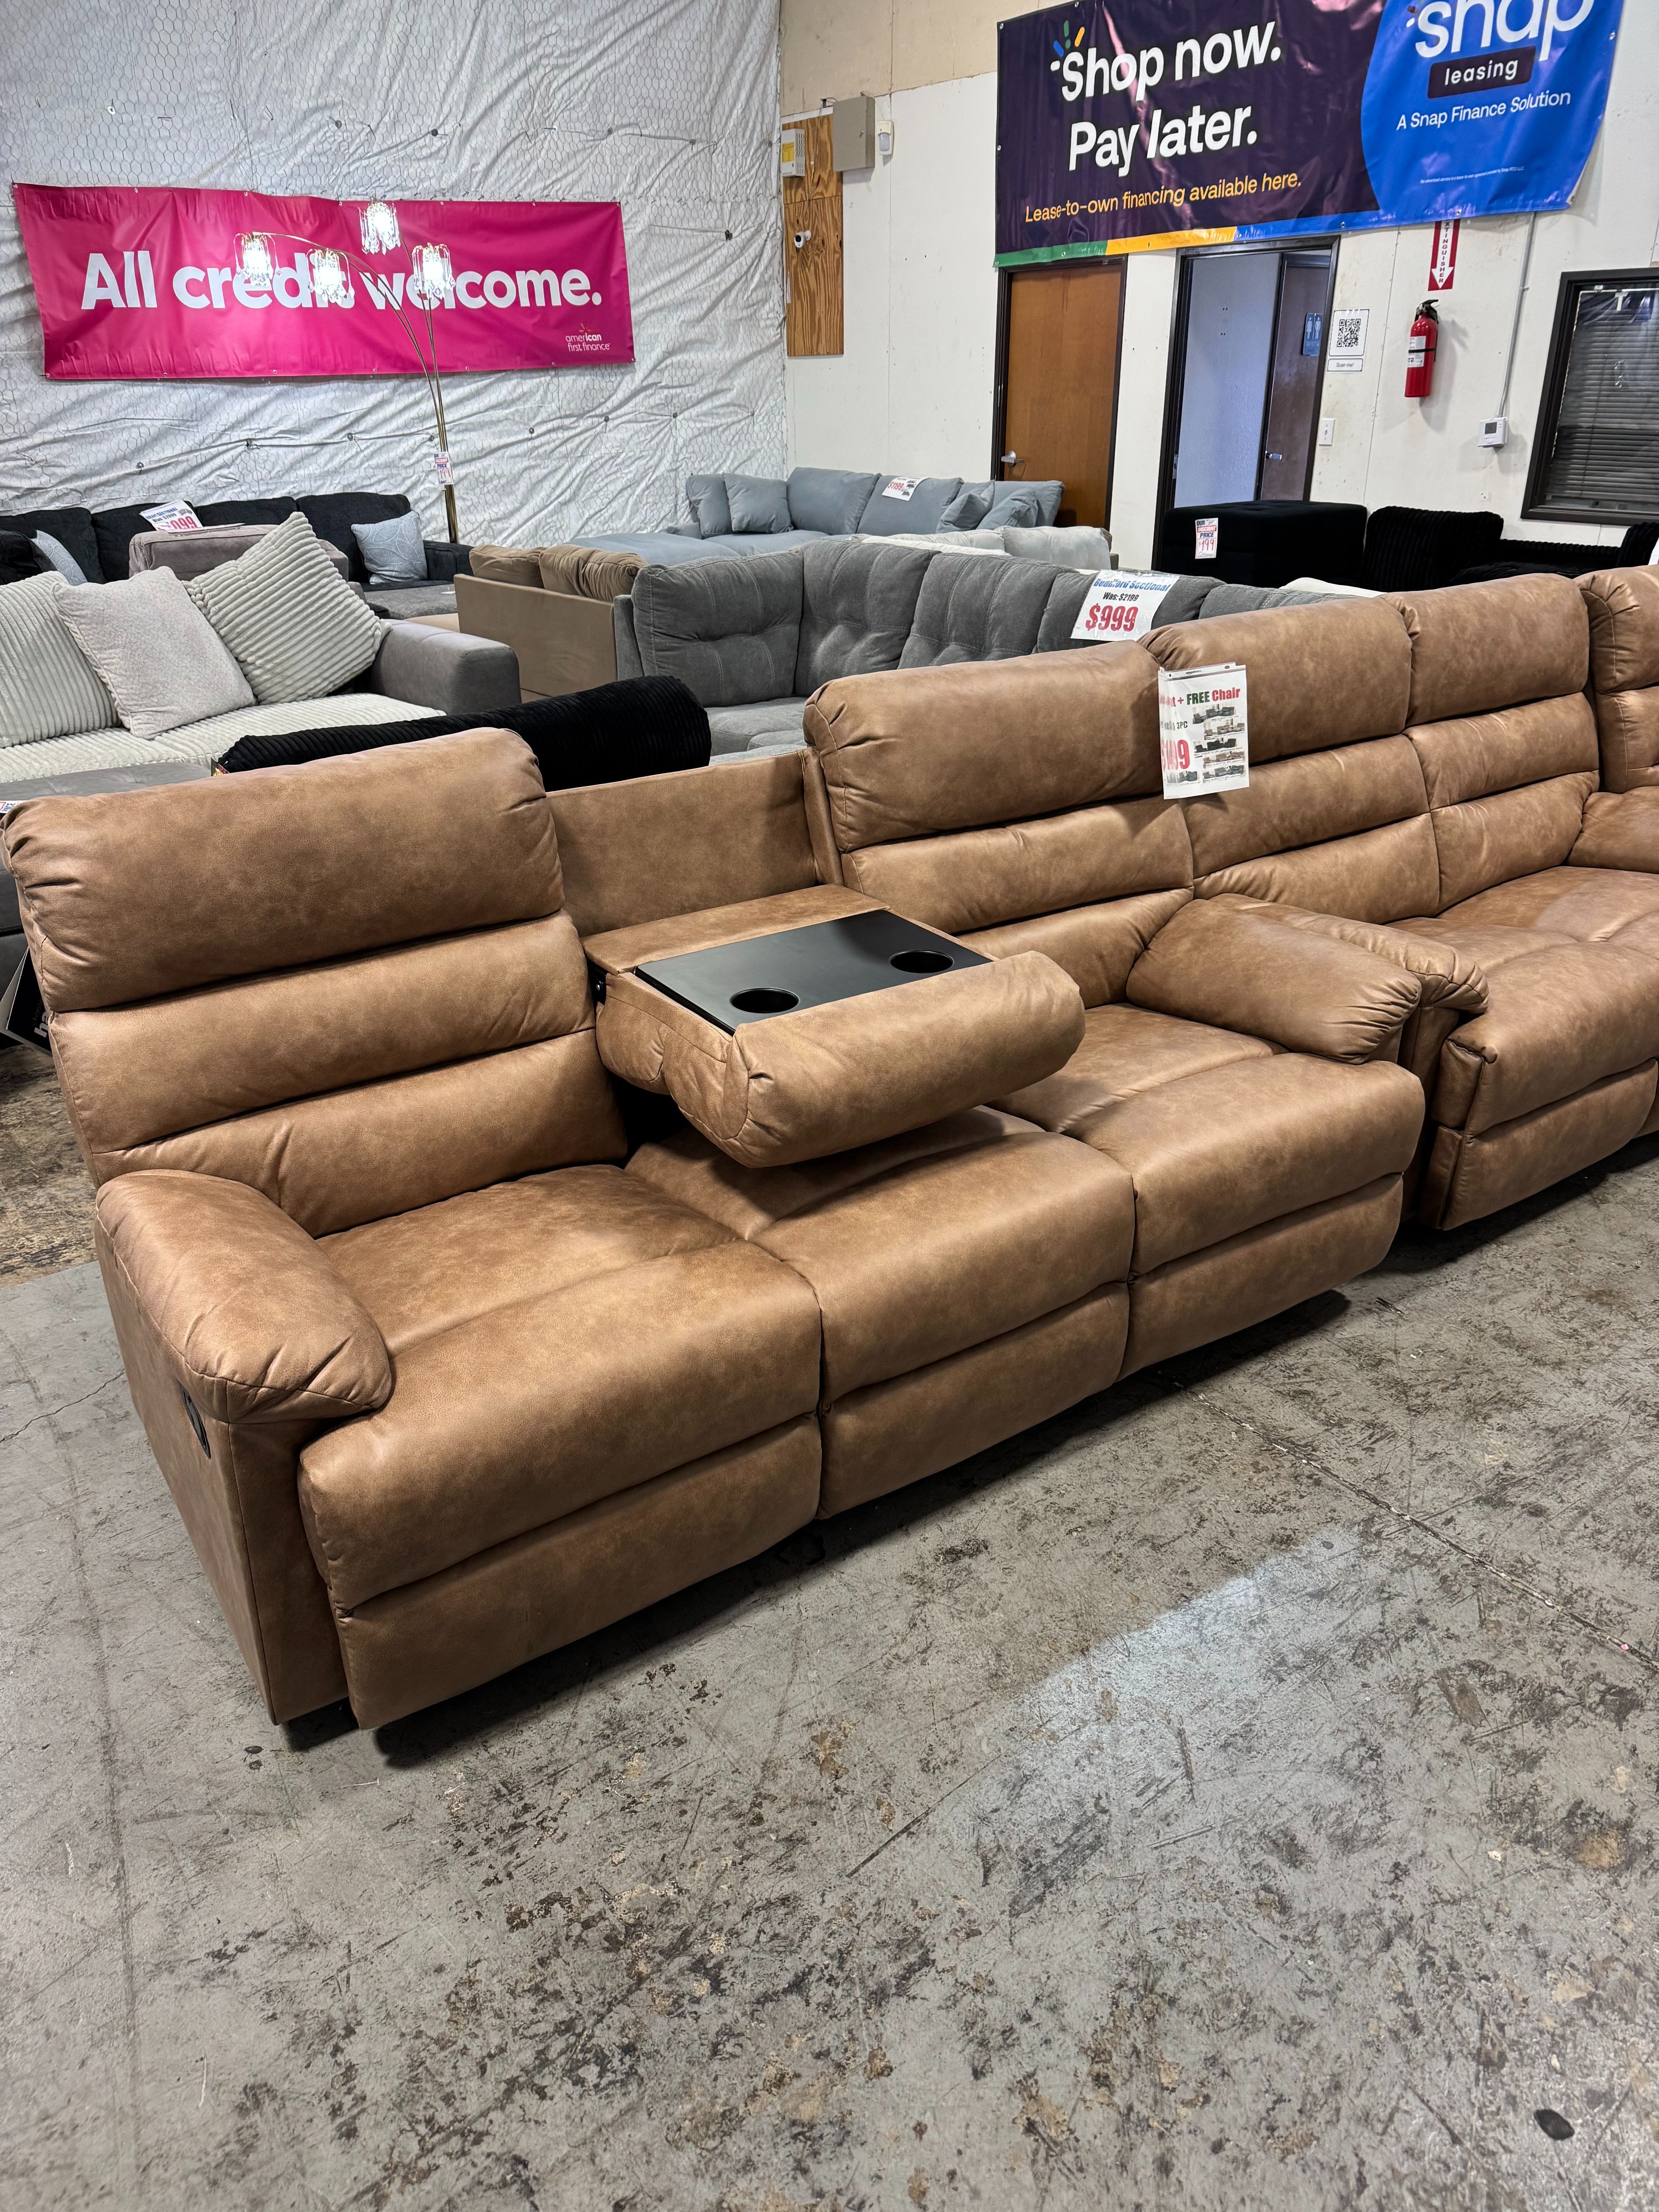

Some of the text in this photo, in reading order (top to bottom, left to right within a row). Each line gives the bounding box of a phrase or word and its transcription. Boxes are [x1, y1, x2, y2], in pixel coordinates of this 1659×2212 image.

[1416, 0, 1594, 61] snap
[1062, 21, 1281, 101] Shop now.
[1444, 59, 1518, 85] leasing
[1396, 90, 1571, 131] A Snap Finance Solution
[1069, 105, 1257, 177] Pay later.
[1025, 172, 1302, 222] Lease-to-own financing available here.
[1438, 221, 1451, 283] XTINGUISHER
[81, 250, 157, 309] All
[358, 258, 602, 310] welcome.
[565, 332, 602, 342] american
[568, 342, 582, 352] first
[888, 481, 904, 490] $1199
[169, 516, 198, 529] 099
[1103, 592, 1139, 601] Was: $2199
[1129, 581, 1172, 591] Sectional
[1085, 603, 1139, 632] $999
[1186, 691, 1210, 705] FREE
[1212, 687, 1240, 702] Chair
[1176, 721, 1188, 730] 3PC
